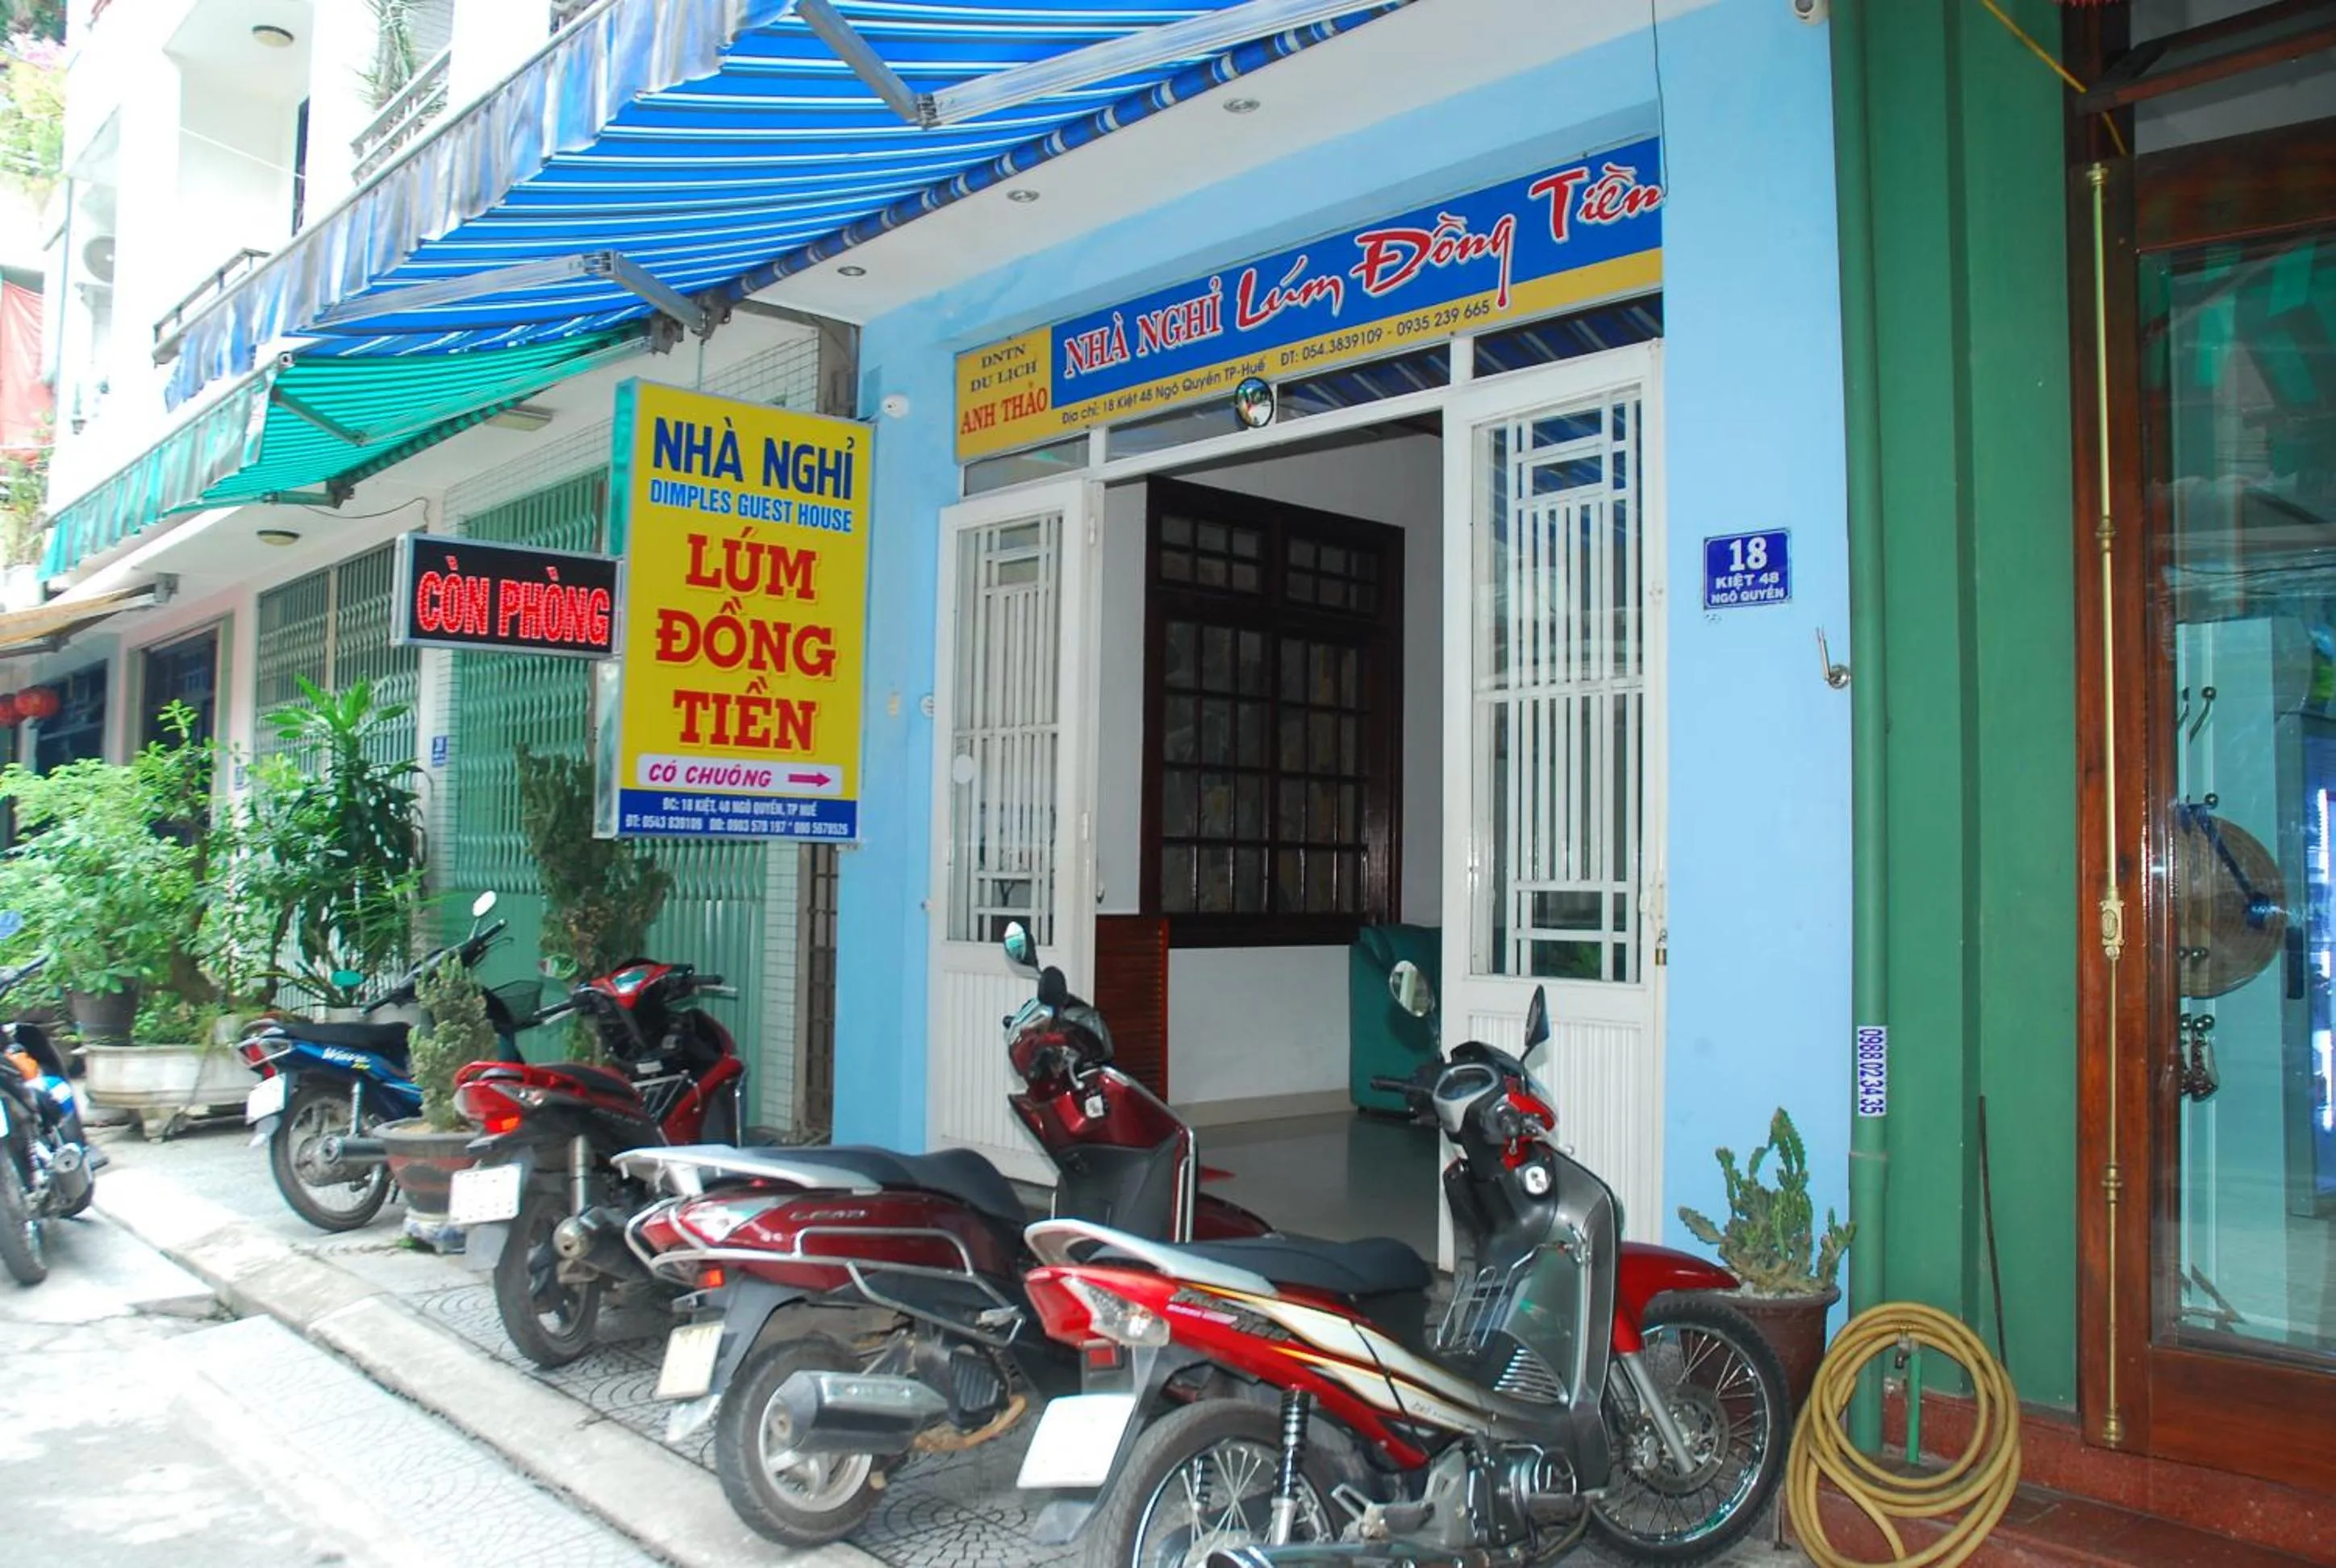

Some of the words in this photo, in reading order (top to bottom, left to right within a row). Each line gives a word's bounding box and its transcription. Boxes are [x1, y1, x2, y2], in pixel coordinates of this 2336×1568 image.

[1063, 311, 1130, 379] NHÀ
[1137, 277, 1223, 357] NGHỈ
[1237, 255, 1344, 332] Lúm
[1350, 211, 1515, 309] Đồng
[1529, 162, 1663, 243] Tiền
[982, 343, 1026, 369] DNTN
[1103, 402, 1115, 414] 18
[1396, 315, 1429, 337] 0935
[1433, 308, 1460, 328] 239
[1464, 299, 1491, 319] 665
[960, 402, 996, 435] ANH
[1001, 381, 1048, 423] THẢO
[970, 374, 993, 393] DU
[653, 415, 745, 483] NHÀ
[762, 436, 856, 500] NGHỈ
[650, 479, 732, 515] DIMPLES
[737, 494, 793, 524] GUEST
[798, 502, 853, 532] HOUSE
[686, 525, 816, 601] LÚM
[1715, 572, 1756, 591] KIỆT
[1759, 571, 1779, 585] 48
[1729, 536, 1768, 572] 18
[417, 555, 490, 636] CÒN
[497, 565, 611, 645] PHÒNG
[1711, 590, 1738, 604] NGÔ
[656, 596, 836, 678] ĐỒNG
[673, 676, 817, 751] TIỀN
[648, 760, 678, 783] CÓ
[685, 764, 772, 788] CHUÔNG
